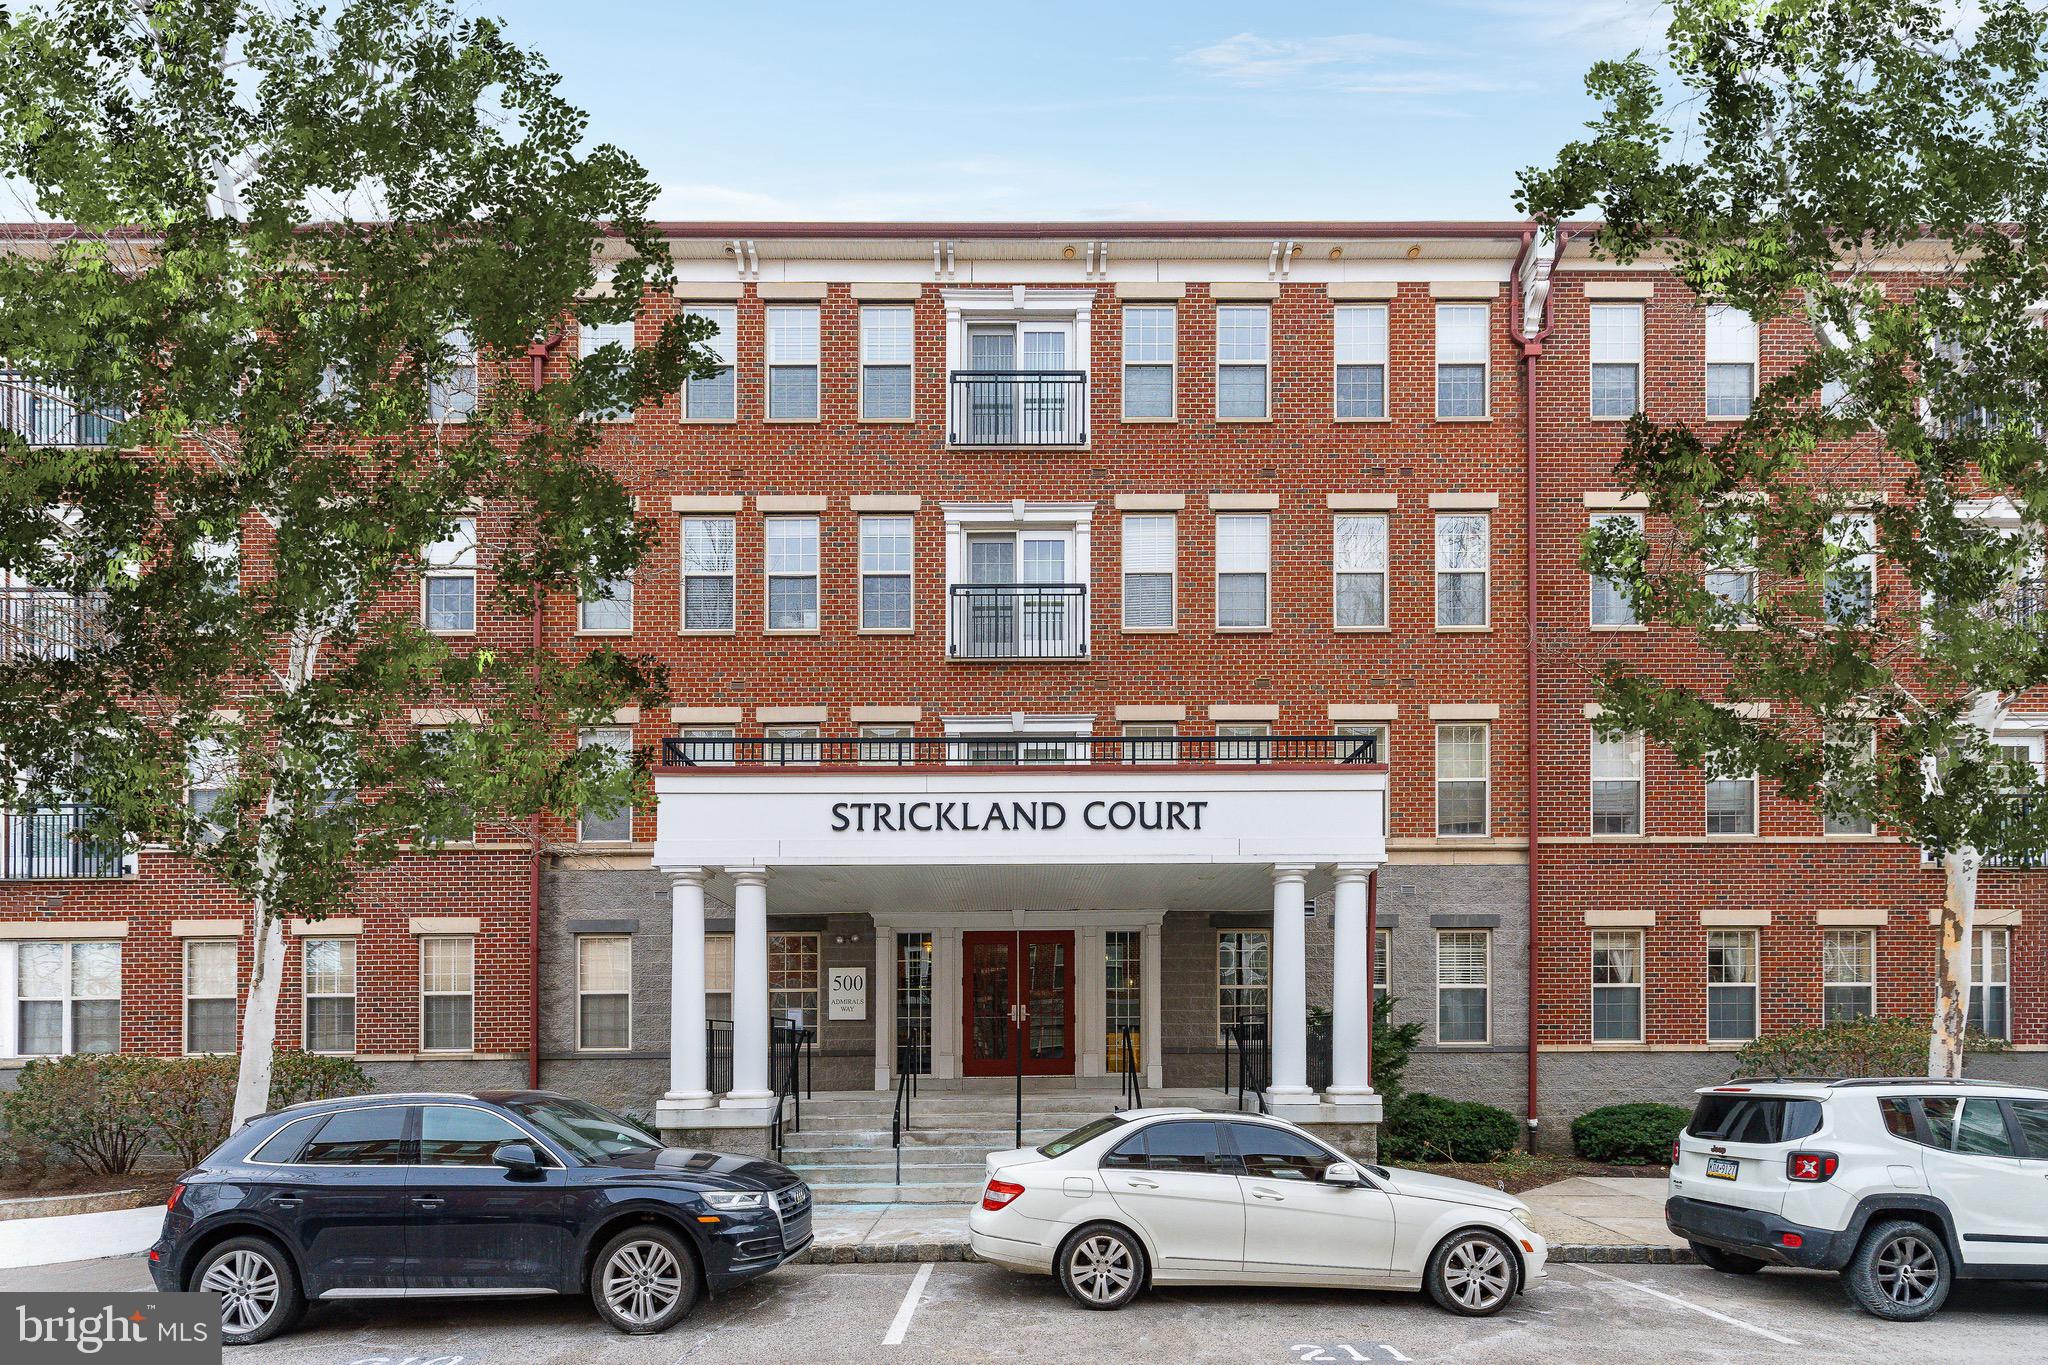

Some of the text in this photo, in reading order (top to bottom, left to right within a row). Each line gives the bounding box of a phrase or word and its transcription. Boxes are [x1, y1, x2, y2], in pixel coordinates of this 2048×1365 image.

[831, 801, 1208, 831] STRICKLAND COURT
[832, 975, 863, 991] 500
[1290, 1344, 1414, 1362] 211
